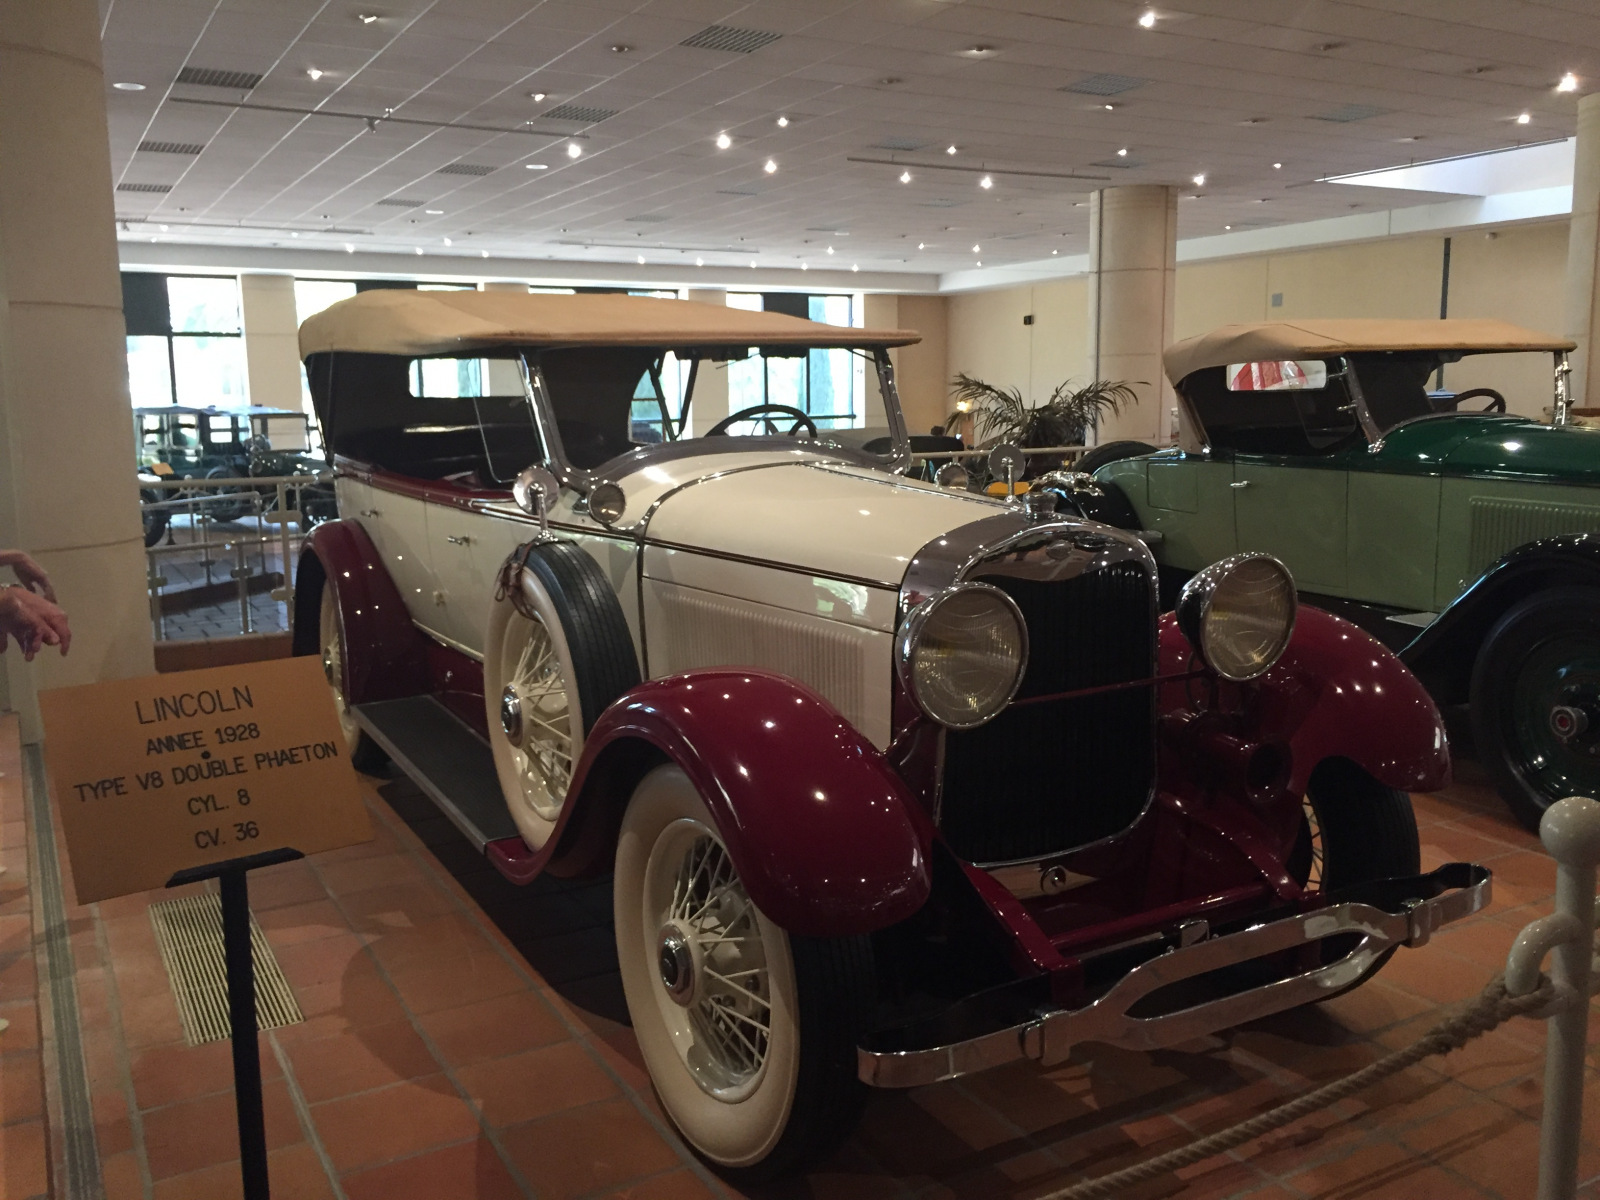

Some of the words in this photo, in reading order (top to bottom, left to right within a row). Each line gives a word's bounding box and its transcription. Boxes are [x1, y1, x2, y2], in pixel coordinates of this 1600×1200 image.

[135, 685, 254, 724] LINCOLN
[146, 730, 207, 756] ANNEE
[215, 722, 261, 745] 1928
[74, 777, 128, 802] TYPE
[136, 771, 164, 791] V8
[172, 756, 248, 785] DOUBLE
[255, 741, 338, 770] PHAETON
[187, 795, 230, 815] CYL.
[237, 789, 250, 805] 8
[194, 829, 226, 849] CV.
[236, 821, 259, 841] 36
